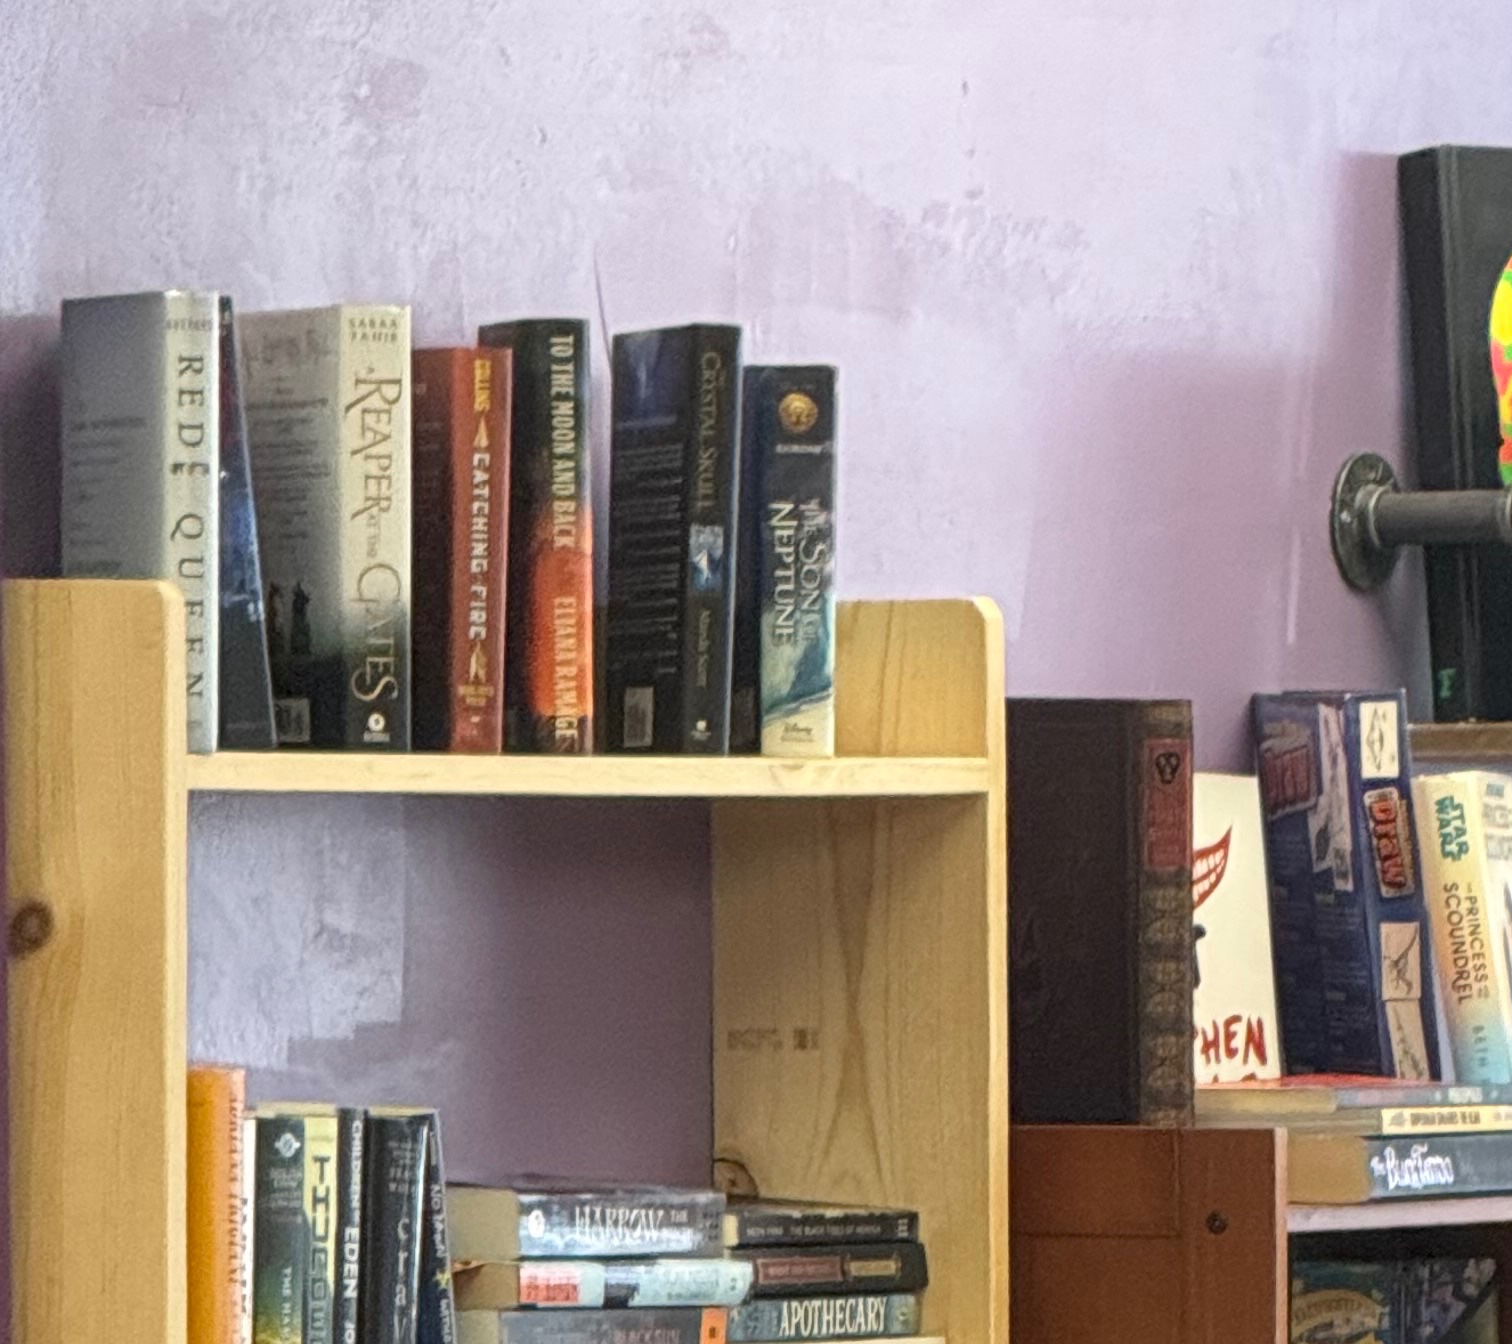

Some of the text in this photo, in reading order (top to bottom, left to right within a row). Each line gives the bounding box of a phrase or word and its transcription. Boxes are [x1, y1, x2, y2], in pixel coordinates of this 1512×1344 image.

[349, 318, 399, 329] SABAA
[344, 371, 403, 521] REAPER
[550, 334, 577, 549] TO THE MOON AND BACK
[696, 352, 722, 509] CRYSTAL SKULL
[171, 355, 205, 698] RED QUEEN
[468, 453, 491, 640] CATCHING FIRE
[767, 502, 799, 645] NEPTUNE
[799, 538, 827, 612] SON
[350, 562, 402, 702] GATES
[554, 665, 579, 741] RAMAGE
[1434, 795, 1462, 862] WARS
[1443, 881, 1472, 1005] SCOUNDREL
[1463, 895, 1489, 984] PRINCESS
[1193, 1013, 1268, 1066] HEN
[350, 1119, 363, 1208] CHILDREN
[429, 1183, 443, 1209] NO
[343, 1226, 360, 1299] EDEN
[575, 1205, 664, 1246] HARROW
[779, 1296, 888, 1337] APOTHECARY
